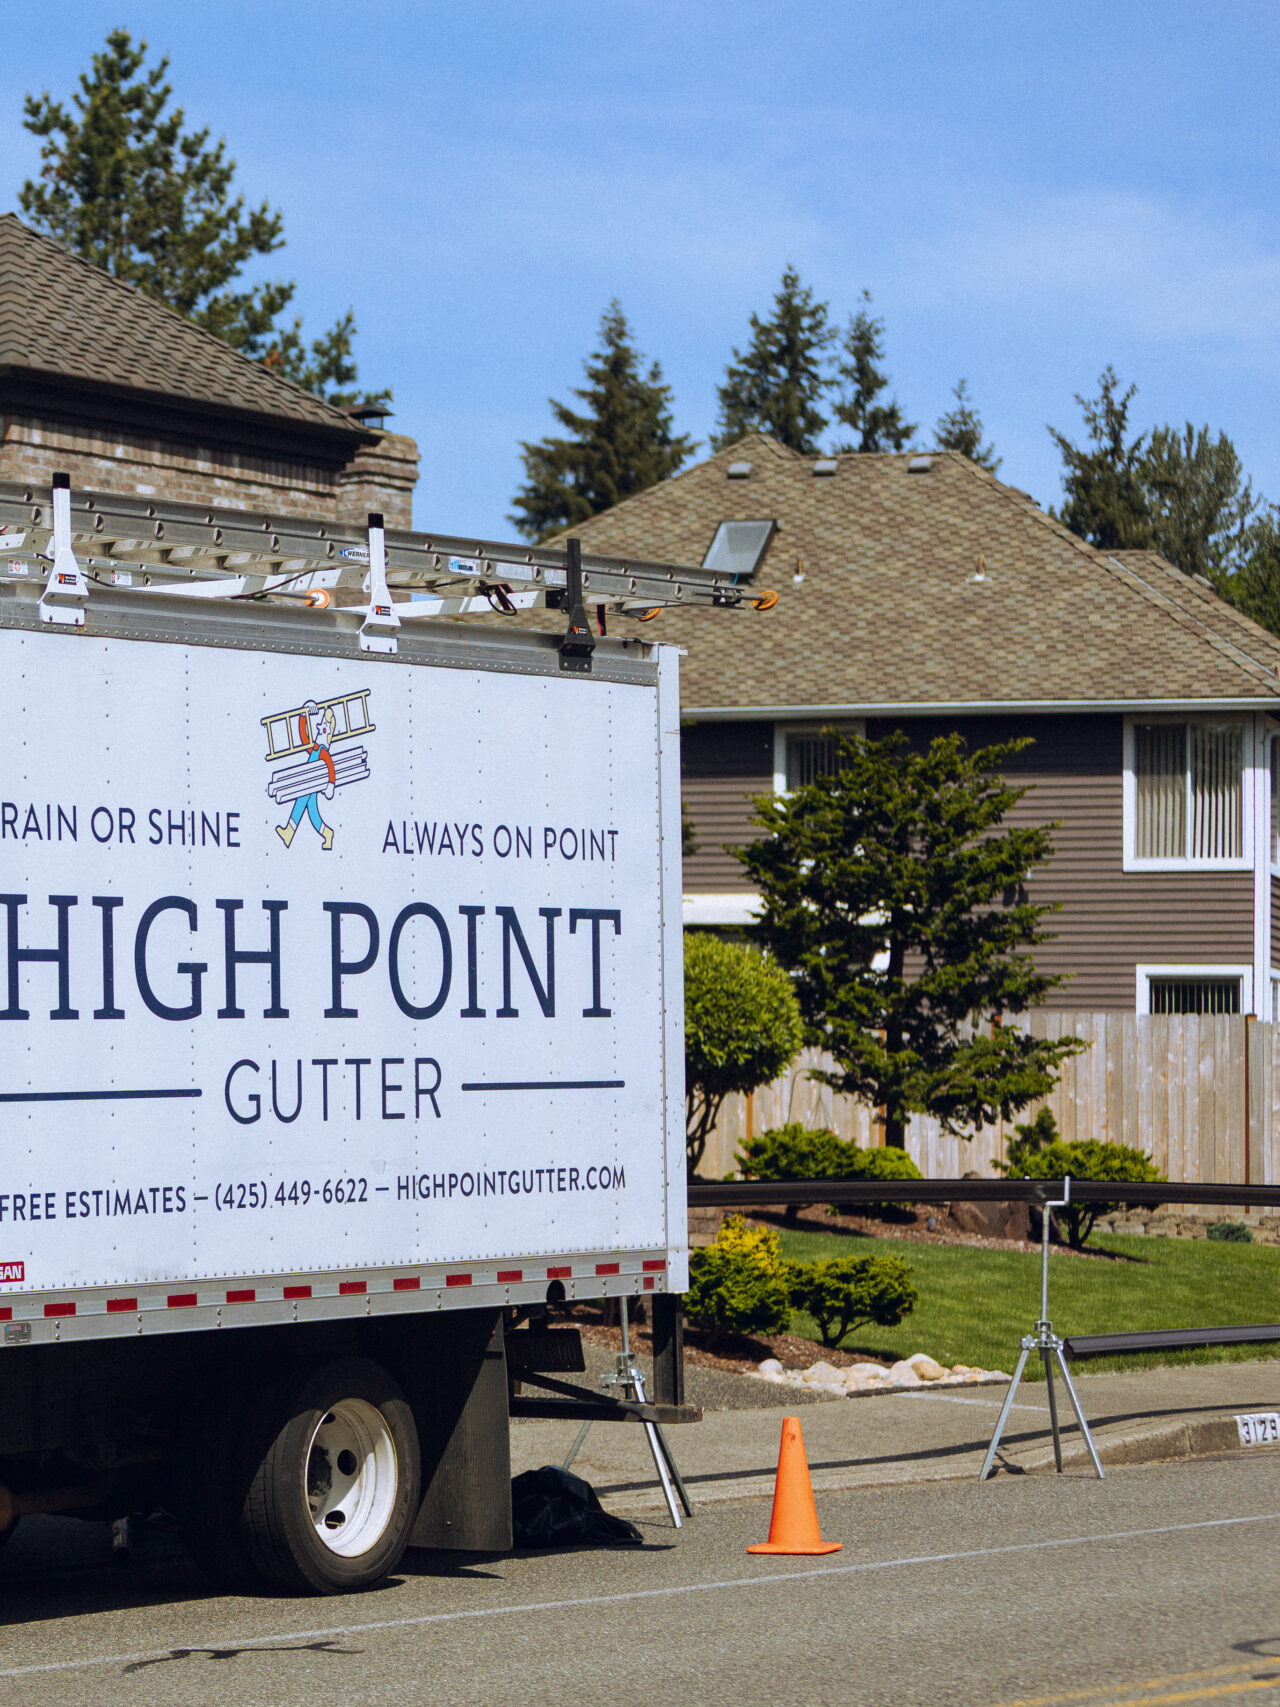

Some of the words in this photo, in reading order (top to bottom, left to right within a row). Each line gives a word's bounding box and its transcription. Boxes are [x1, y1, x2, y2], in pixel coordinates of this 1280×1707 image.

[1, 801, 79, 843] RAIN
[90, 806, 136, 844] OR
[148, 808, 241, 848] SHINE
[382, 819, 484, 858] ALWAYS
[493, 824, 532, 859] ON
[543, 826, 620, 862] POINT
[322, 901, 623, 1021] POINT
[224, 1057, 443, 1126] GUTTER
[65, 1186, 187, 1219] ESTIMATES
[214, 1180, 269, 1212] (425)
[274, 1177, 369, 1207] 449-6622
[397, 1165, 627, 1201] HIGHPOINTGUTTER.COM
[1243, 1418, 1278, 1443] 3129
